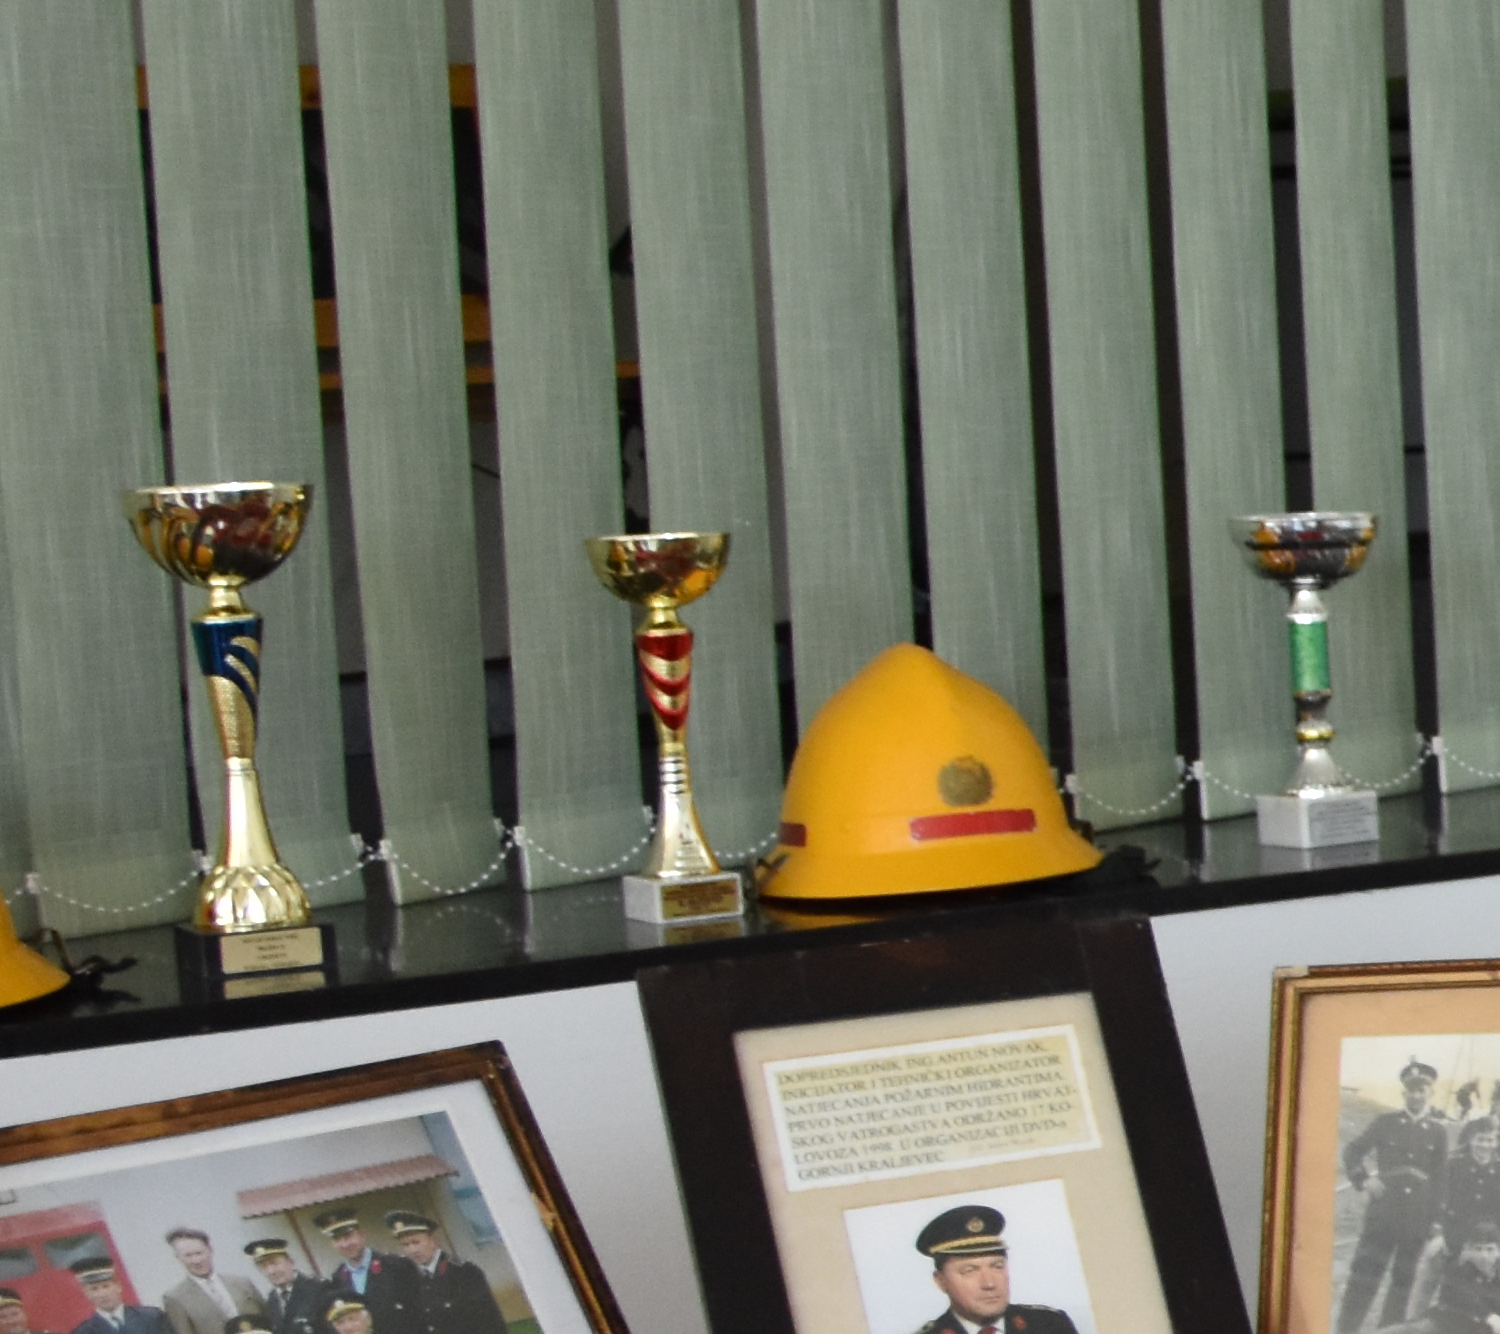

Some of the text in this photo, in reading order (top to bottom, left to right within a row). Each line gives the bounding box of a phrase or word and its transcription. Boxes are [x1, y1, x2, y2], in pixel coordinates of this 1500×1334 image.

[938, 1049, 989, 1063] ANTUN
[954, 1055, 1062, 1077] ORGANIZATOR
[788, 1118, 830, 1131] PRVO
[791, 1134, 834, 1148] SKOG
[794, 1147, 858, 1164] LOVOZA
[798, 1151, 944, 1180] GORNJI KRALJEVEC
